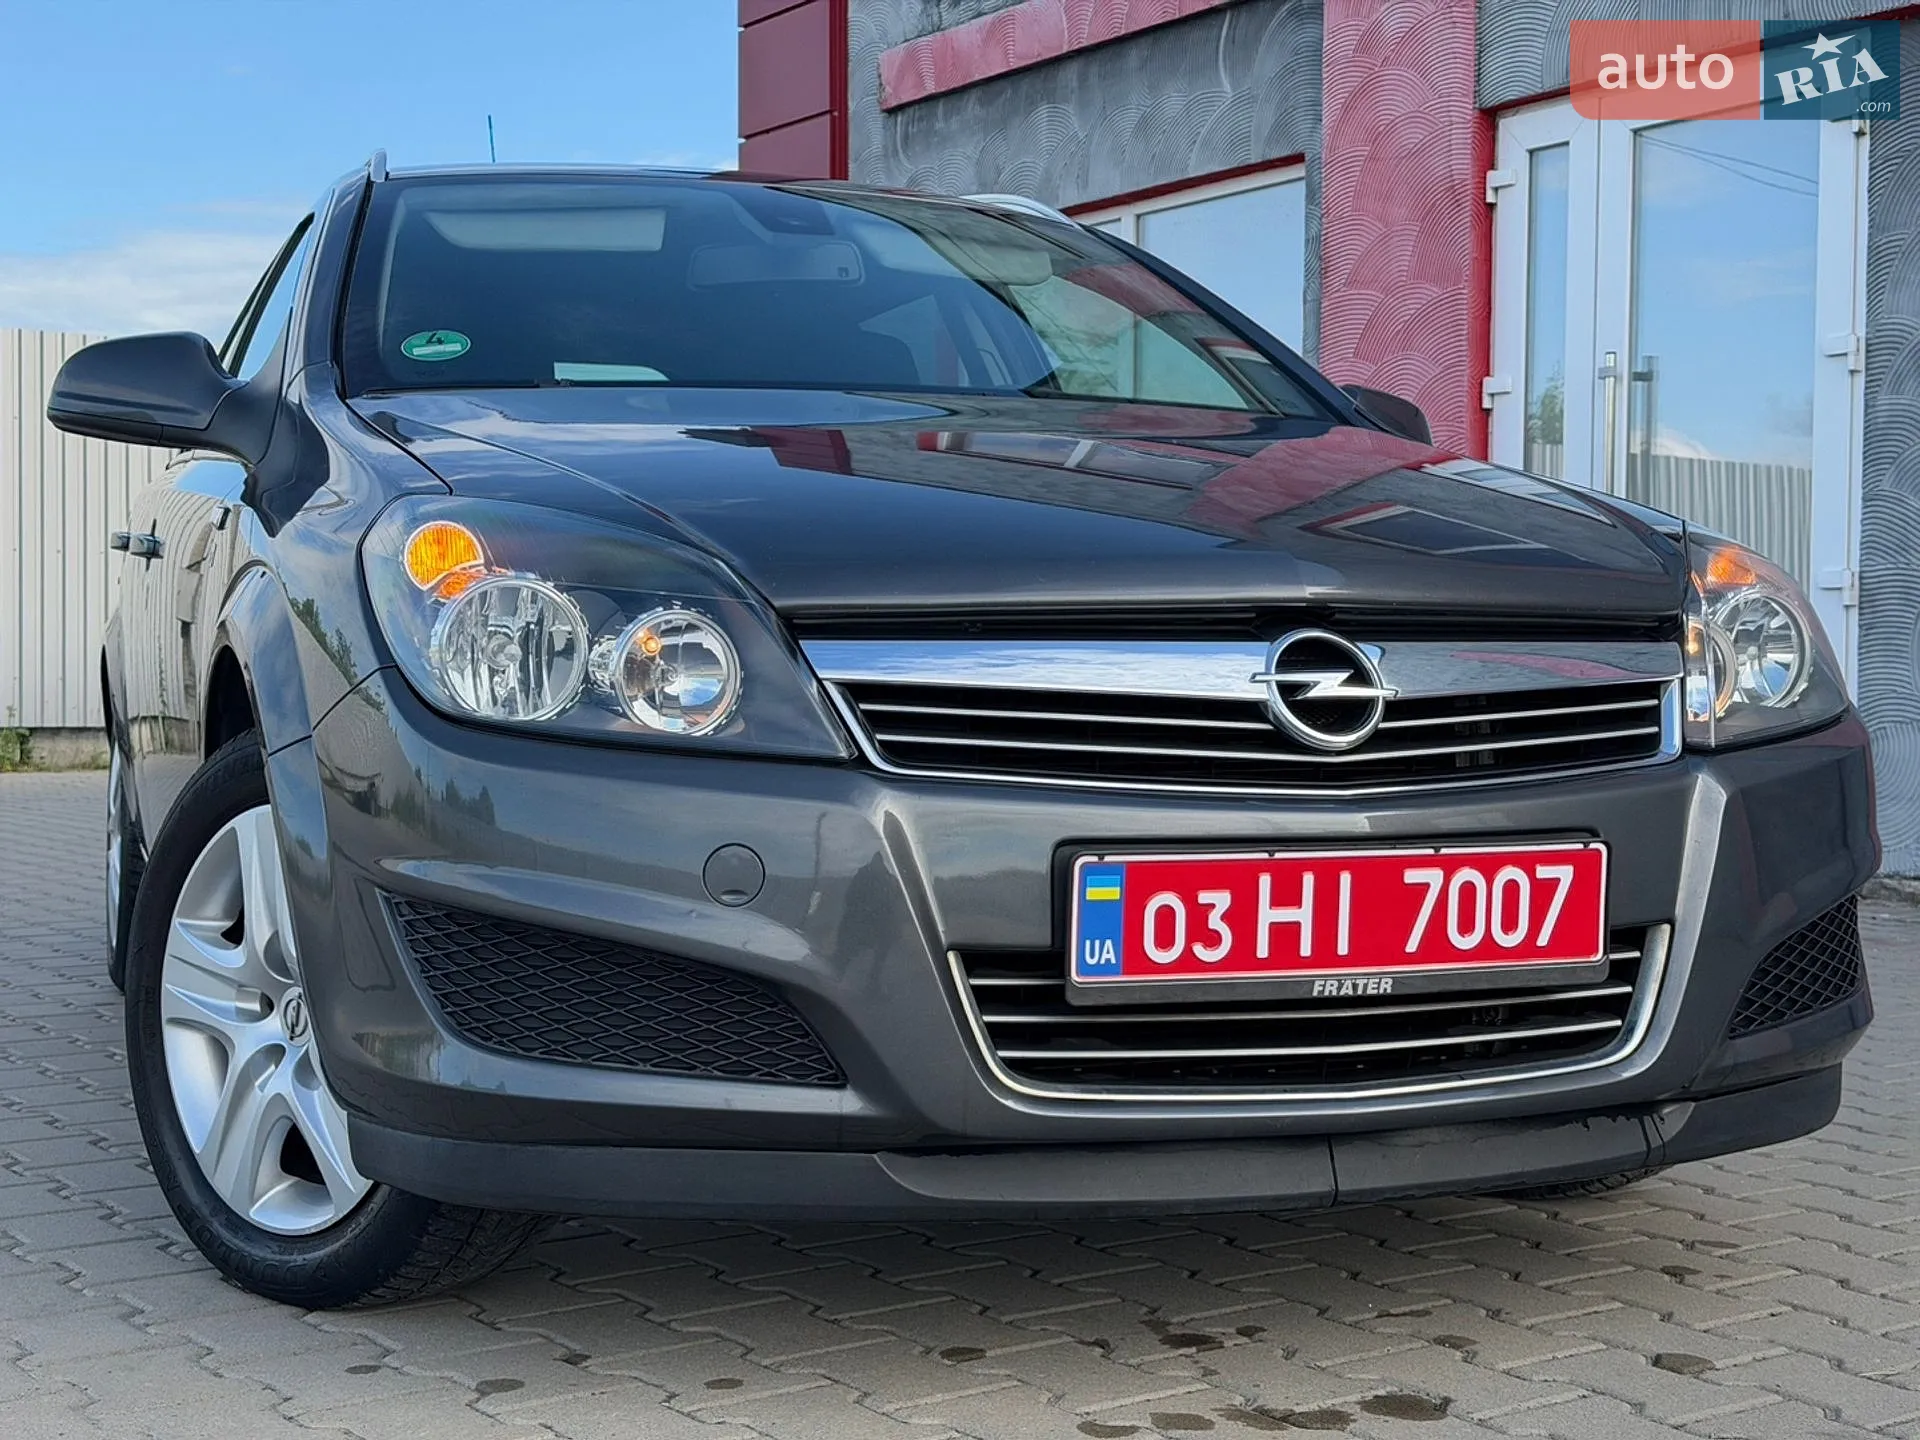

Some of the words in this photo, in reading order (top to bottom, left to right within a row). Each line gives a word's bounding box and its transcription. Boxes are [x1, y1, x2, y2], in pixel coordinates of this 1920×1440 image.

[1143, 890, 1233, 965] 03
[1403, 864, 1575, 954] 7007
[1084, 939, 1116, 966] UA
